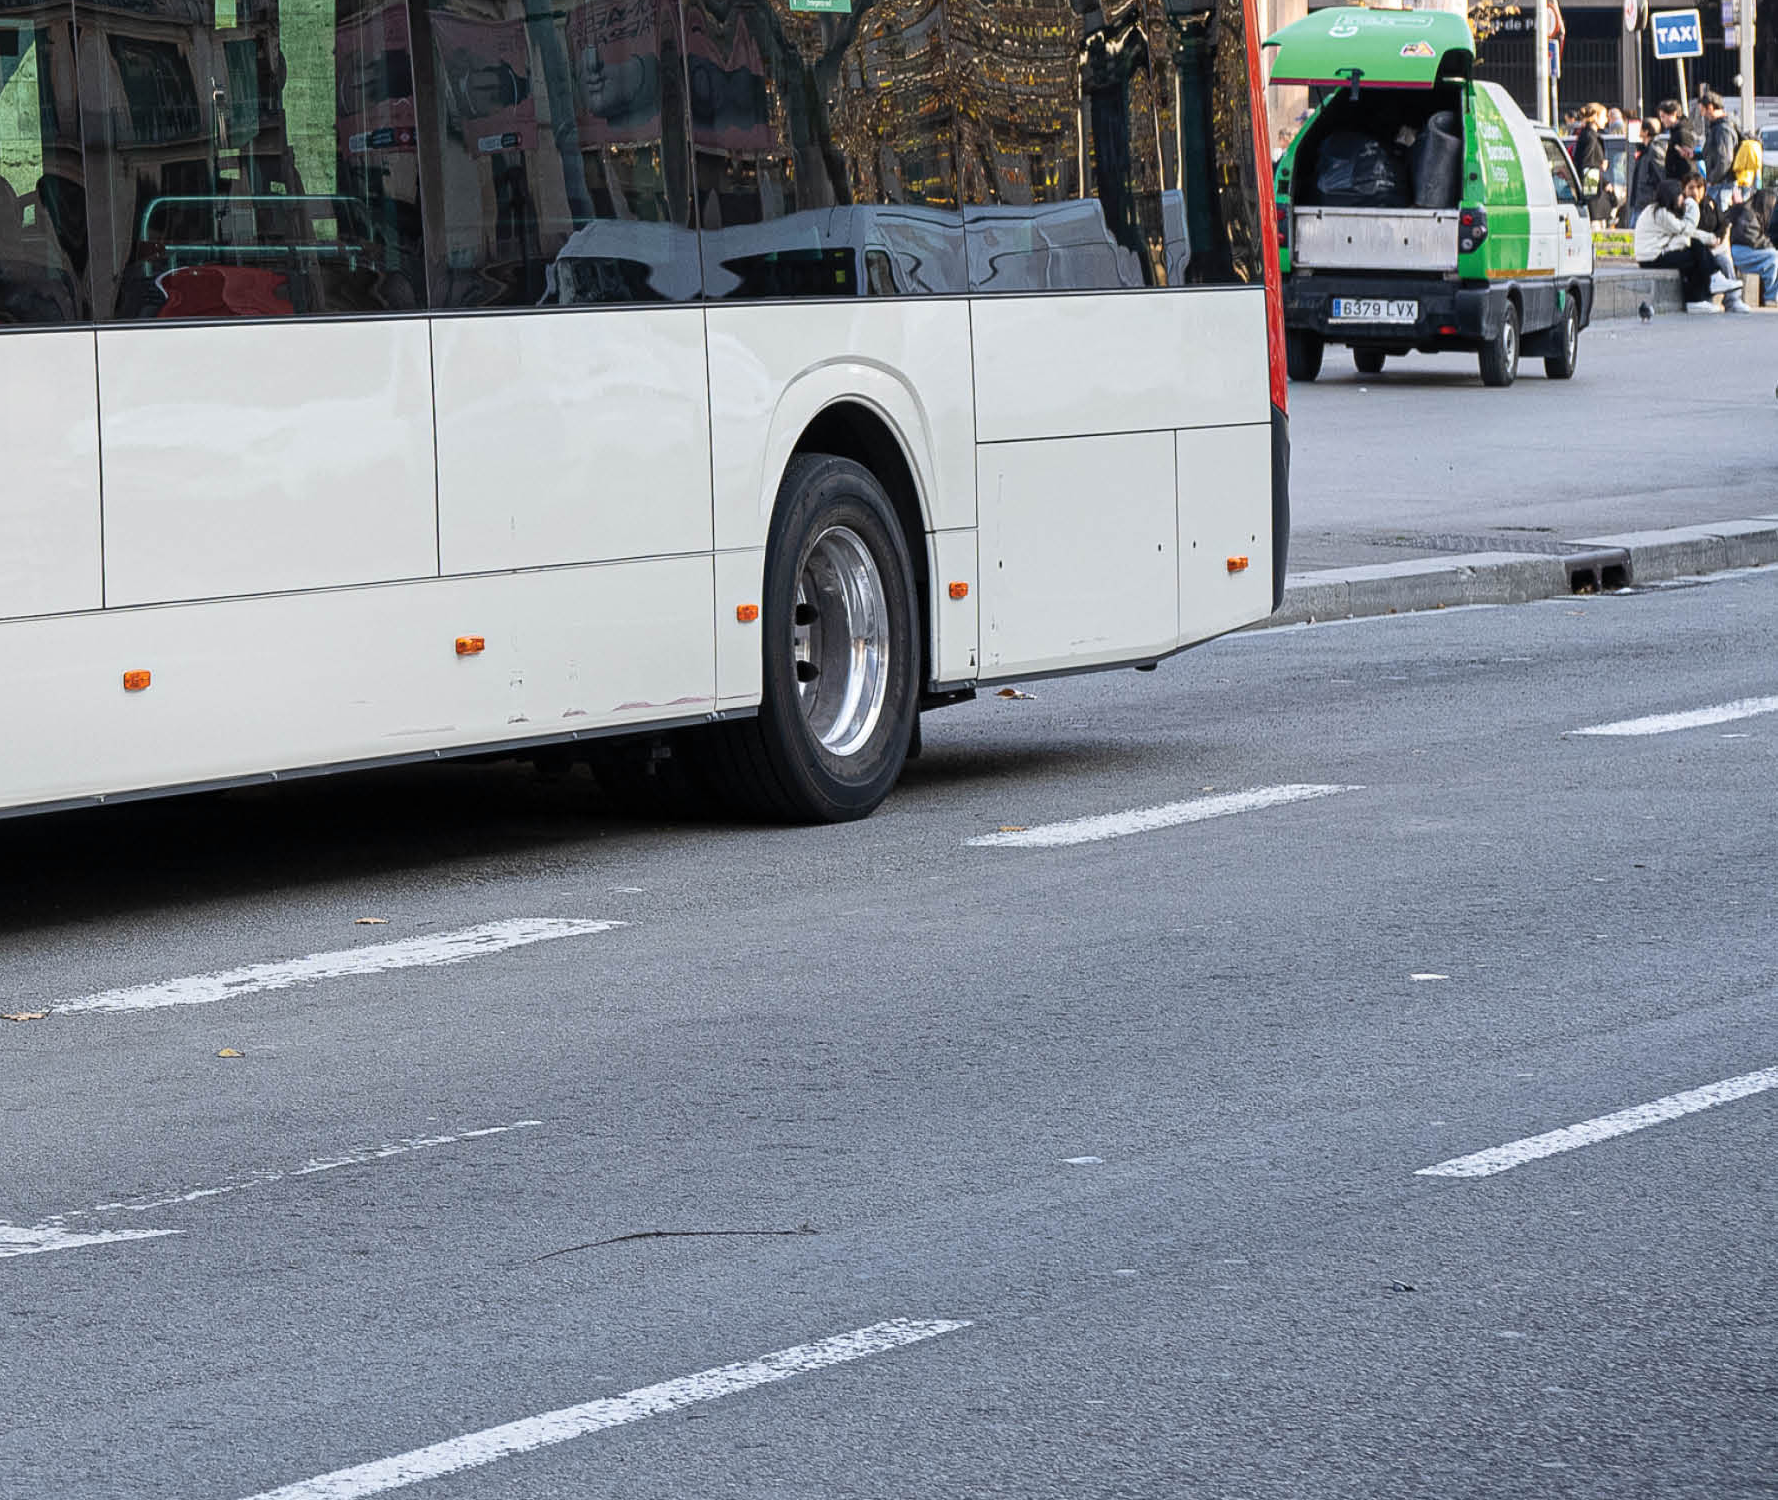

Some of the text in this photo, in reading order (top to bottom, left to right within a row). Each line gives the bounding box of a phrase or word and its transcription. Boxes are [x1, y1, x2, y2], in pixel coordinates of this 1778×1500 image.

[1658, 25, 1699, 44] TAXI
[1344, 302, 1415, 317] 6379 LVX
